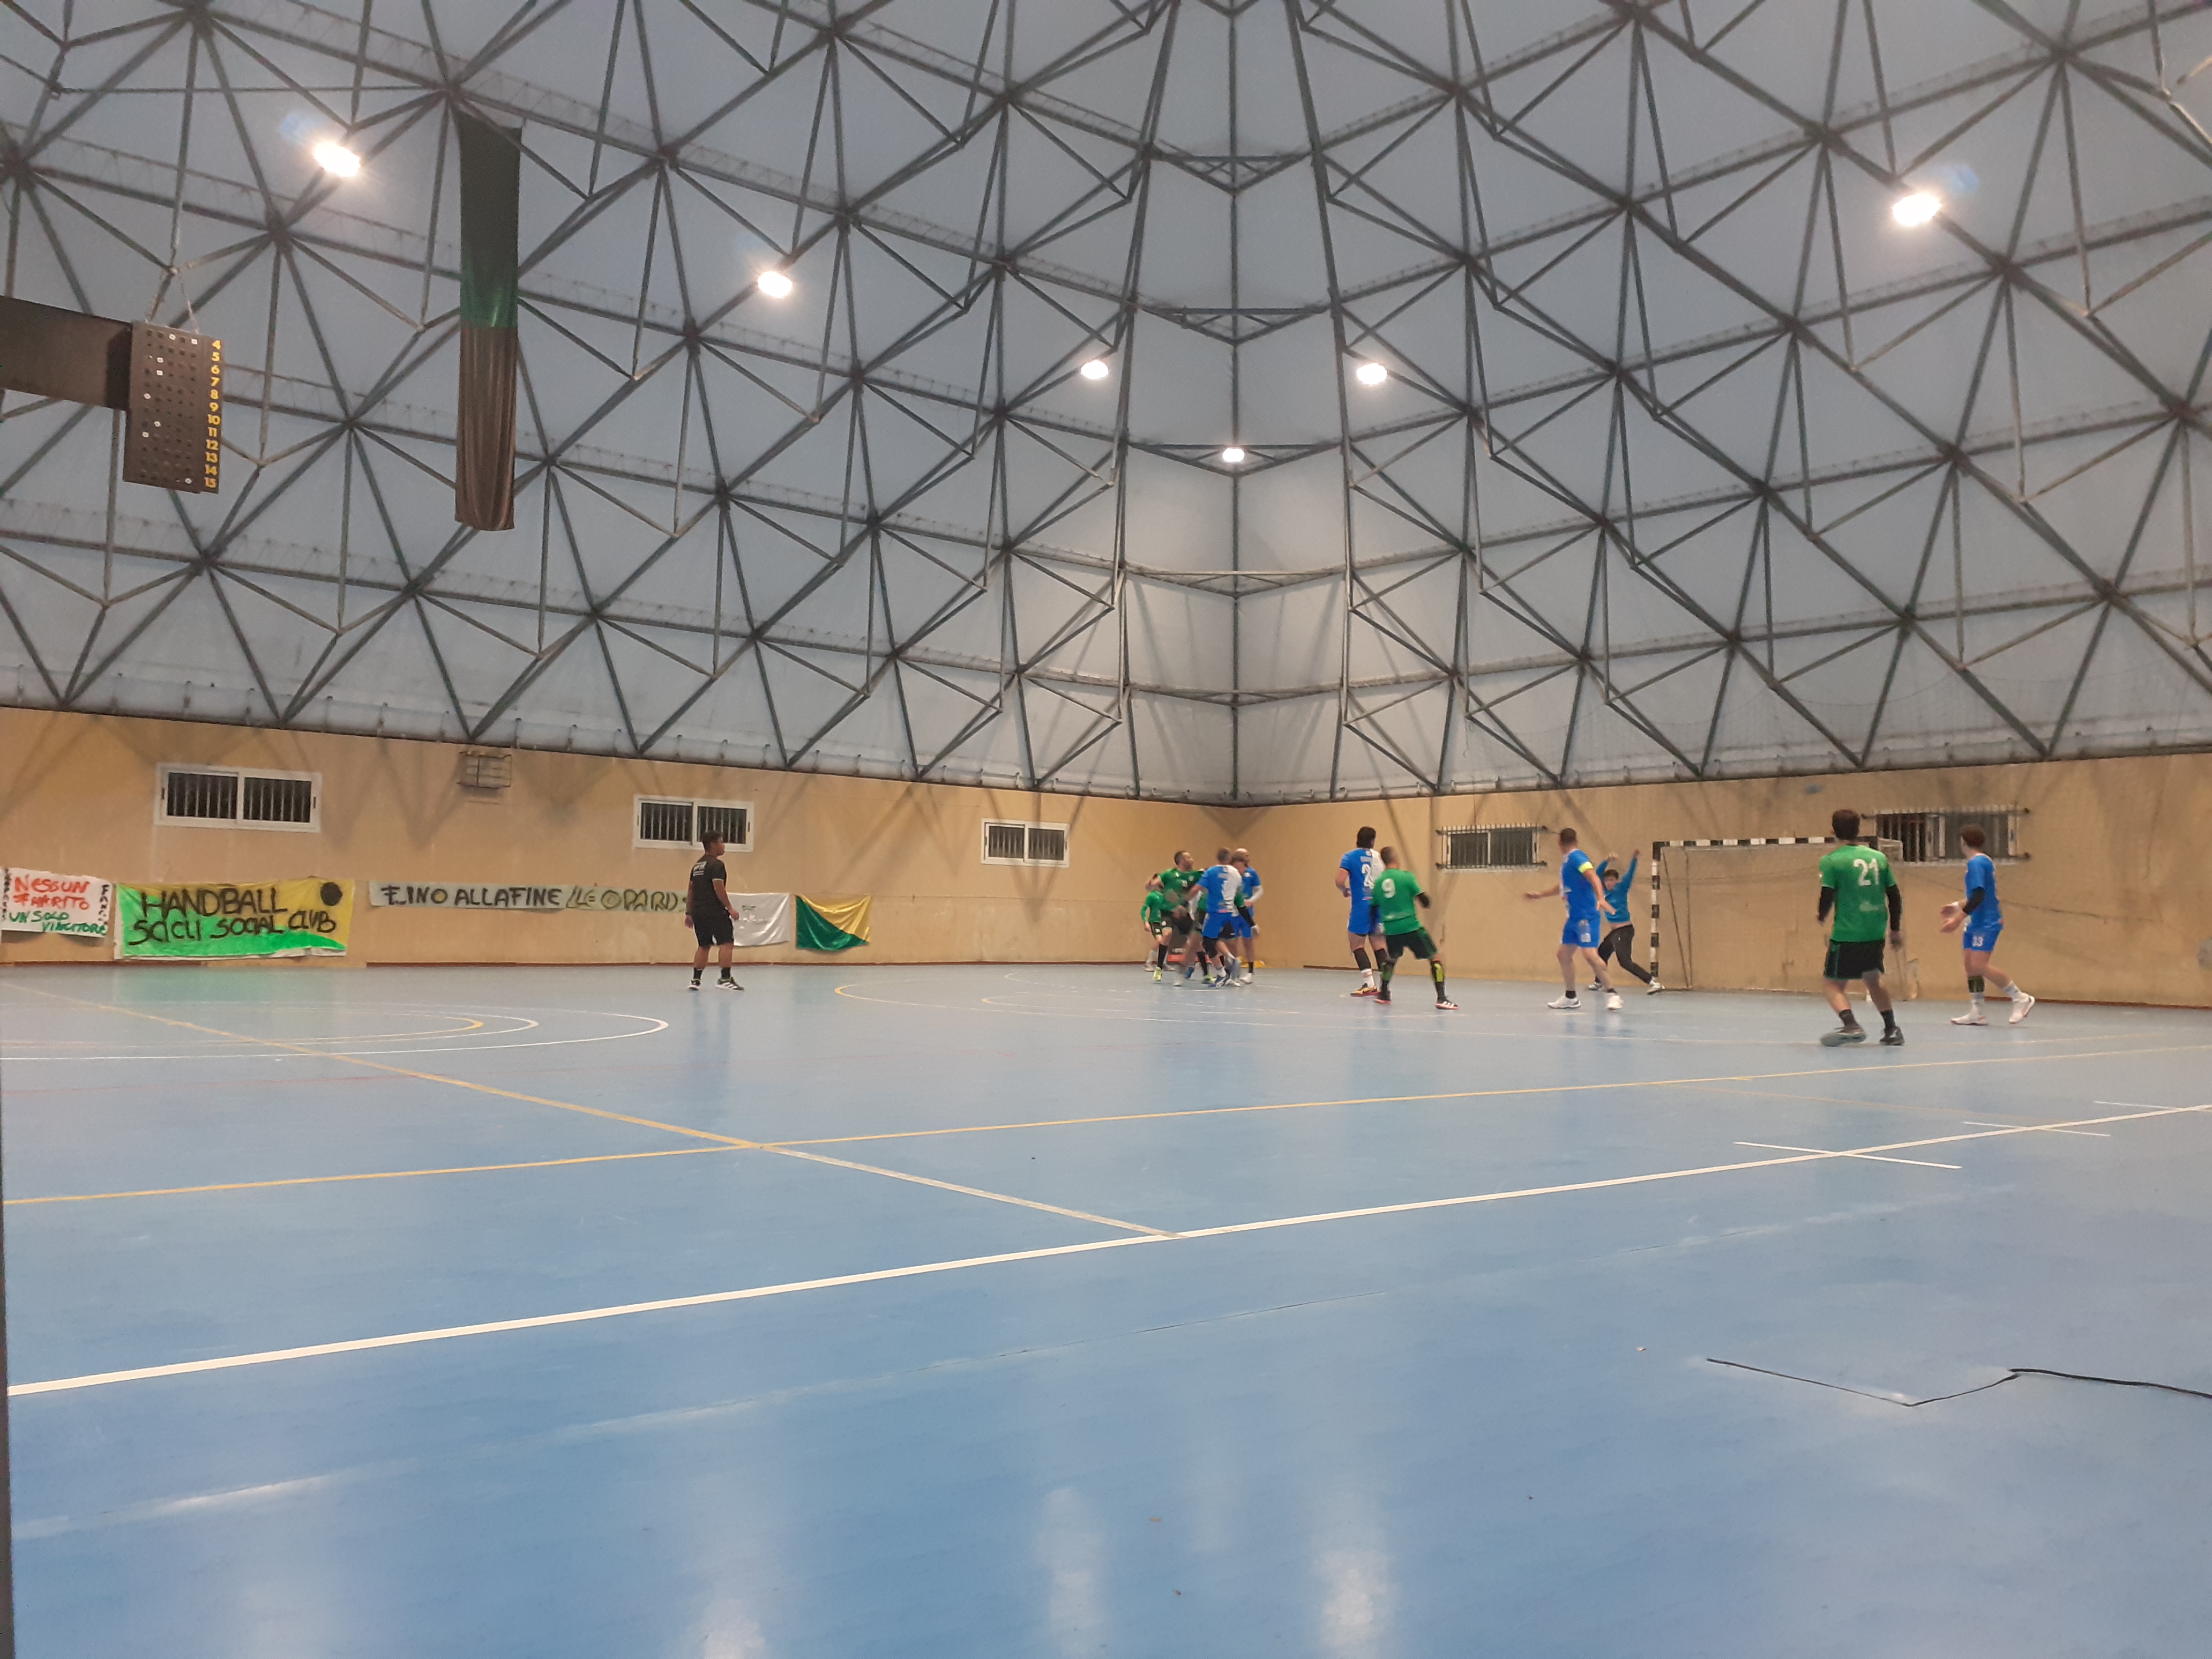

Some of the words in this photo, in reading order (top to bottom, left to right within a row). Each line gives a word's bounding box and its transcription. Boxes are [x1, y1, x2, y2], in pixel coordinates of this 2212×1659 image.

[212, 340, 220, 349] 4
[212, 352, 220, 362] 5
[211, 365, 220, 375] 6
[211, 377, 220, 386] 7
[210, 390, 219, 399] 8
[210, 402, 219, 412] 9
[207, 414, 220, 425] 10
[208, 427, 217, 437] 11
[206, 439, 219, 450] 12
[205, 452, 218, 462] 13
[205, 464, 217, 475] 14
[204, 477, 216, 488] 15
[1853, 858, 1879, 886] 21
[14, 875, 90, 893] NESSUN
[1381, 878, 1395, 898] 9
[140, 887, 288, 918] HANDBALL
[9, 911, 30, 923] UN
[210, 915, 285, 939] SOCIAL
[288, 909, 337, 933] CLUB
